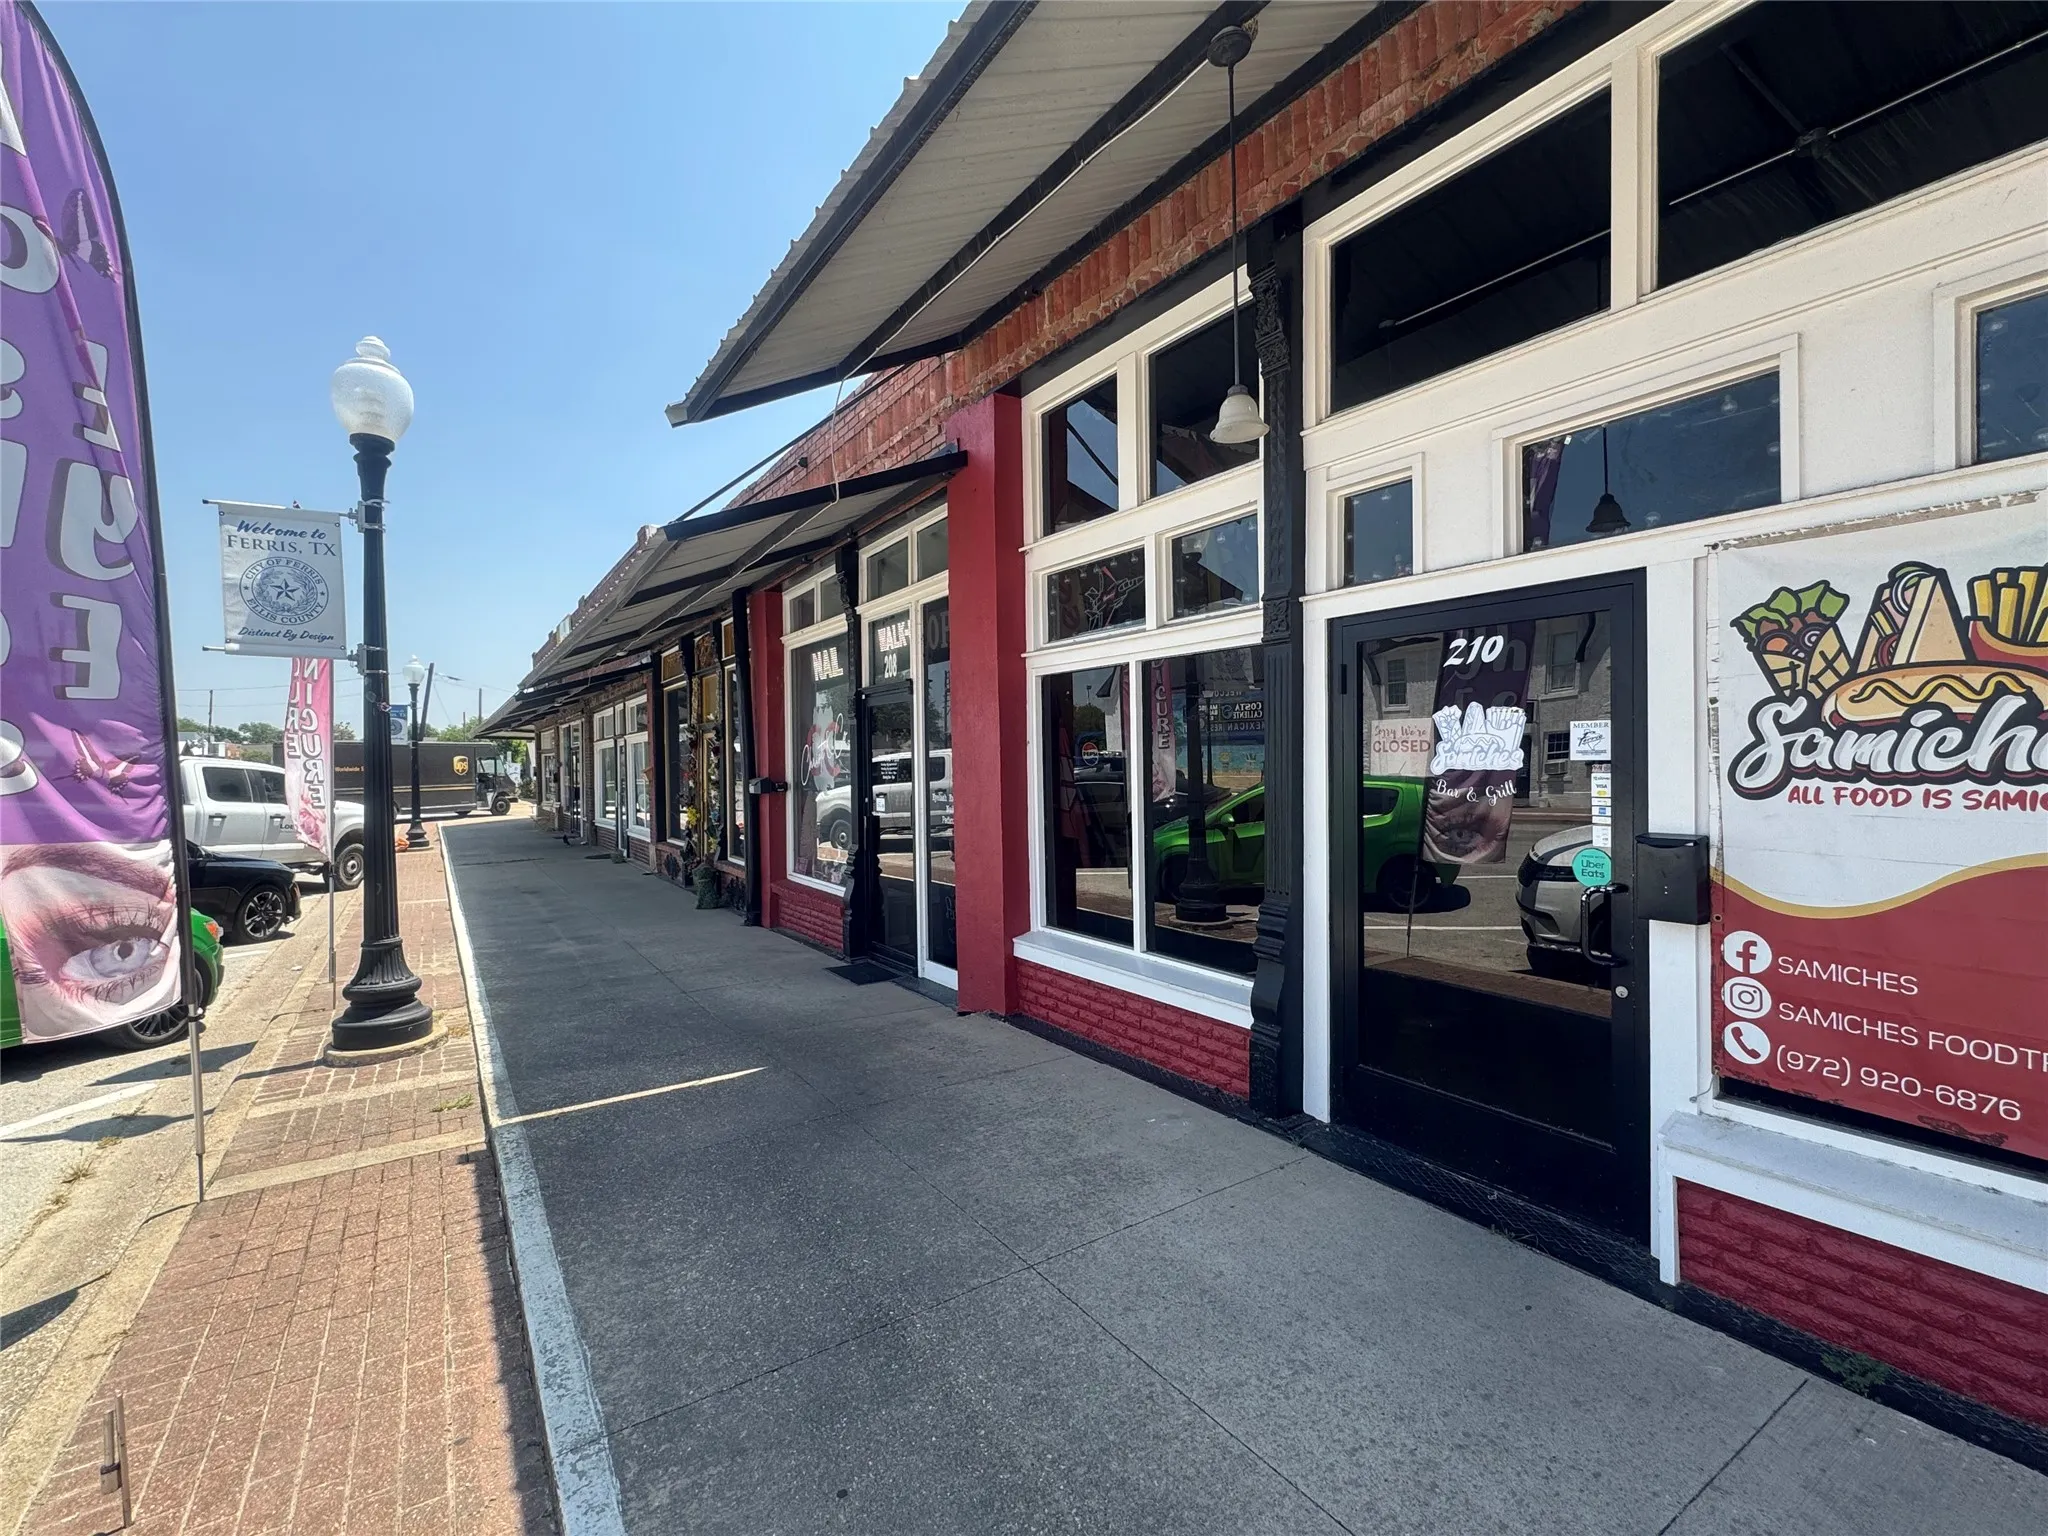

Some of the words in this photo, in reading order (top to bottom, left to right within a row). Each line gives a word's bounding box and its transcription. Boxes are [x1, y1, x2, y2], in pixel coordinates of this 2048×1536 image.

[237, 519, 308, 539] Welcome
[311, 528, 327, 540] to
[227, 534, 303, 555] FERRIS,
[308, 541, 337, 557] TX
[245, 561, 264, 580] CITY
[266, 558, 282, 566] OF
[286, 559, 324, 585] FERRIS
[247, 598, 278, 622] ELLIS
[281, 603, 324, 624] COUNTY
[238, 626, 281, 638] Distinct
[282, 629, 298, 642] By
[300, 630, 335, 643] Design
[1443, 634, 1505, 668] 210
[884, 653, 898, 679] 208
[1374, 725, 1397, 740] Sorry
[1401, 724, 1427, 737] We're
[1373, 739, 1431, 753] CLOSED
[455, 761, 468, 772] ups
[1436, 779, 1460, 798] Bar
[1466, 786, 1479, 803] &
[1485, 780, 1517, 806] Grill
[1787, 785, 1825, 806] ALL
[1832, 786, 1912, 808] FOOD
[1923, 787, 1953, 810] IS
[1581, 859, 1605, 869] Uber
[1581, 868, 1605, 879] Eats
[1778, 955, 1919, 996] SAMICHES
[1778, 1002, 1919, 1047] SAMICHES
[1928, 1030, 2048, 1073] FOODT
[1776, 1044, 1851, 1087] (972)
[1860, 1066, 2022, 1122] 920-6876
